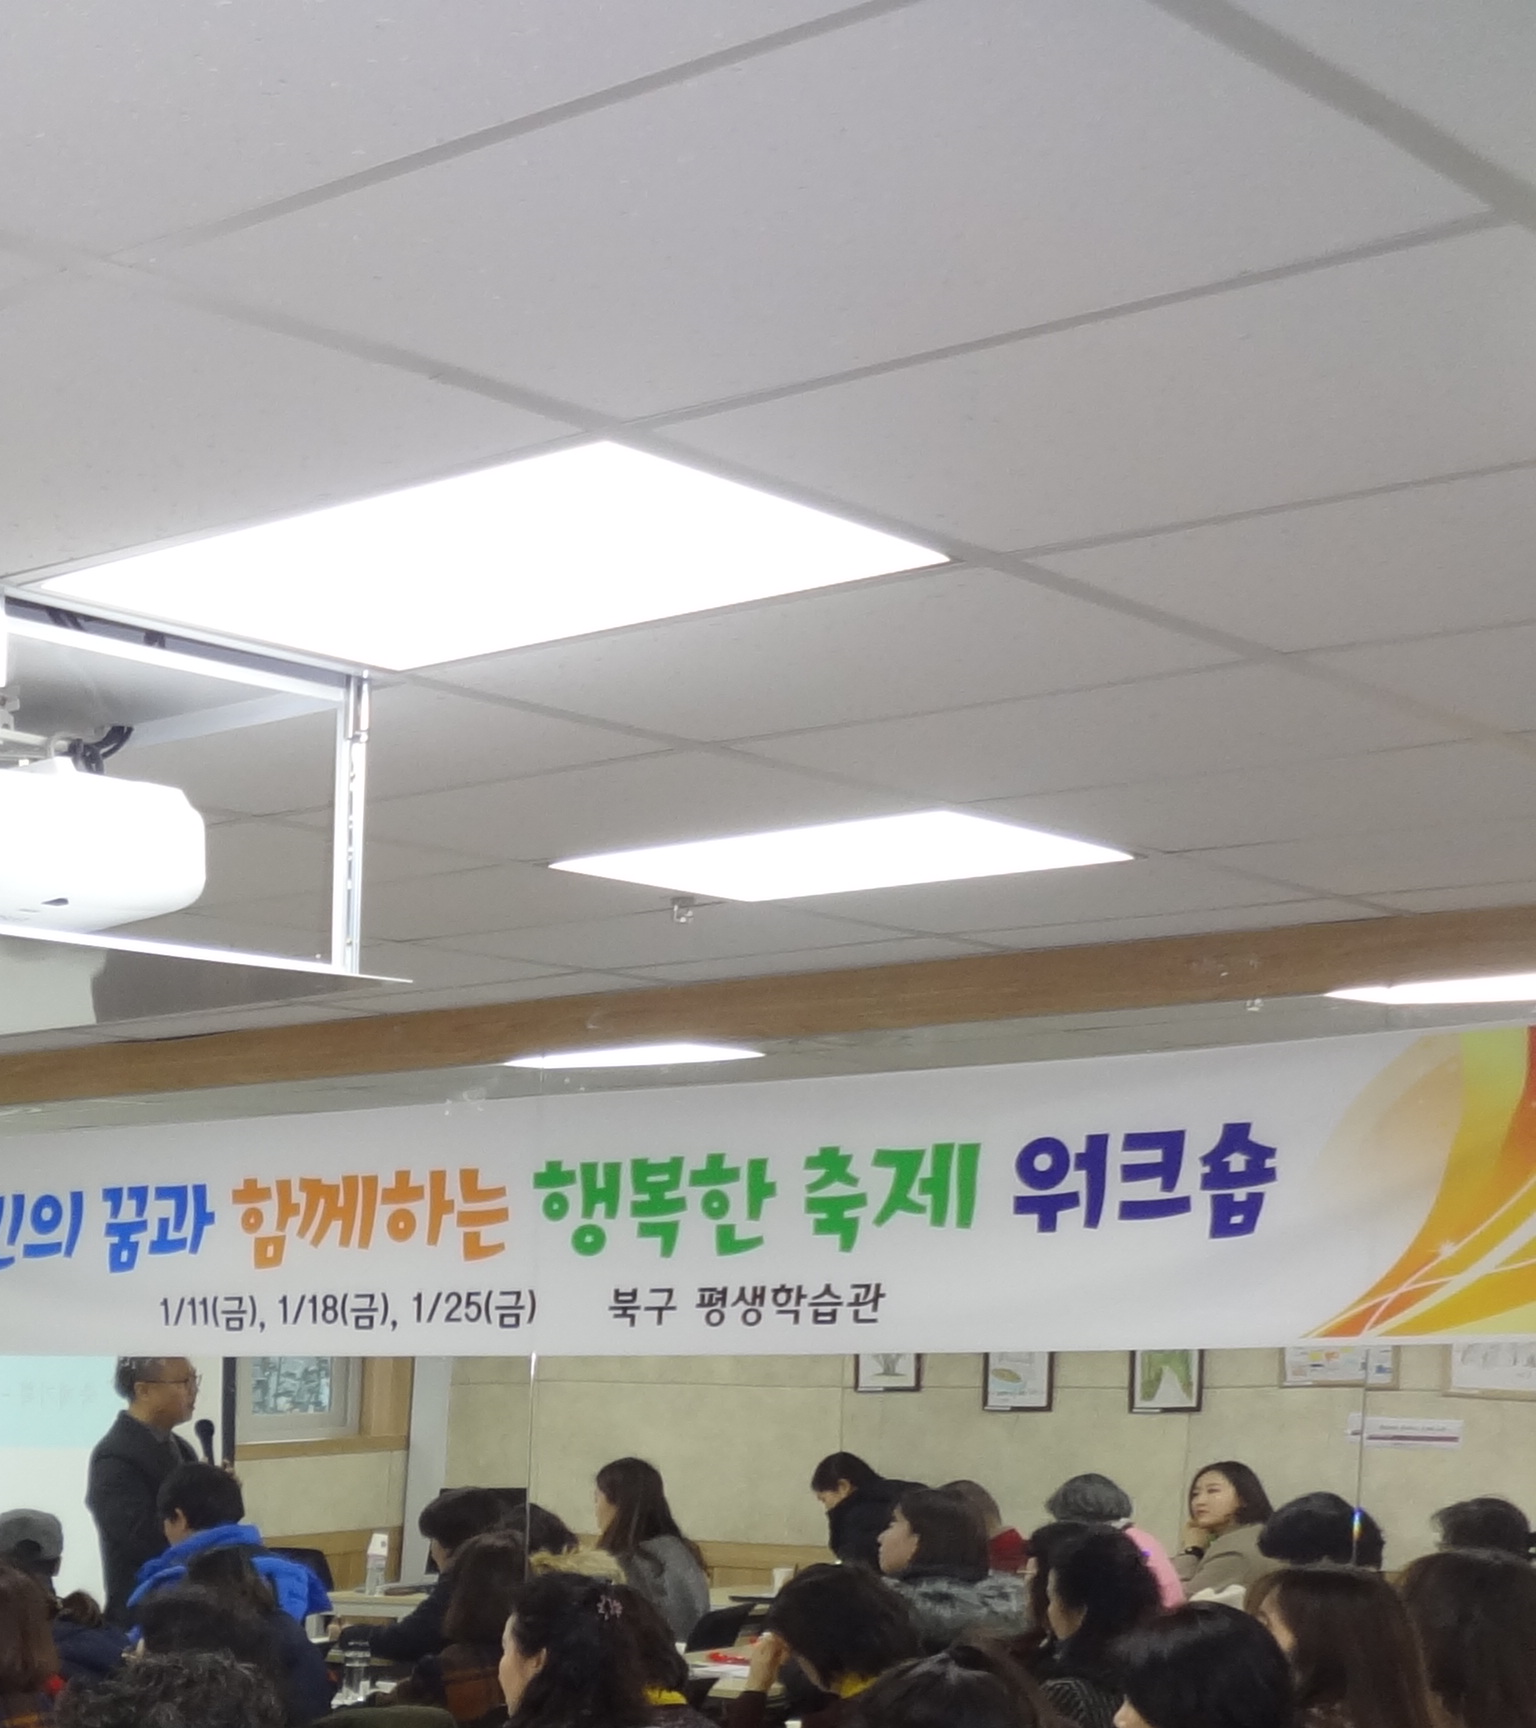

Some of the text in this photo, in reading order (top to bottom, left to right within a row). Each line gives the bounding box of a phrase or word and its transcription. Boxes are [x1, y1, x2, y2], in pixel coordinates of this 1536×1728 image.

[101, 1182, 217, 1274] 꿈과
[230, 1166, 510, 1270] 함께하는
[532, 1151, 778, 1259] 행복한
[803, 1141, 982, 1254] 축제
[1012, 1120, 1279, 1240] 워크숍
[159, 1281, 887, 1332] 1/11(금), 1/18(금), 1/25(금) 북구 평생학습관
